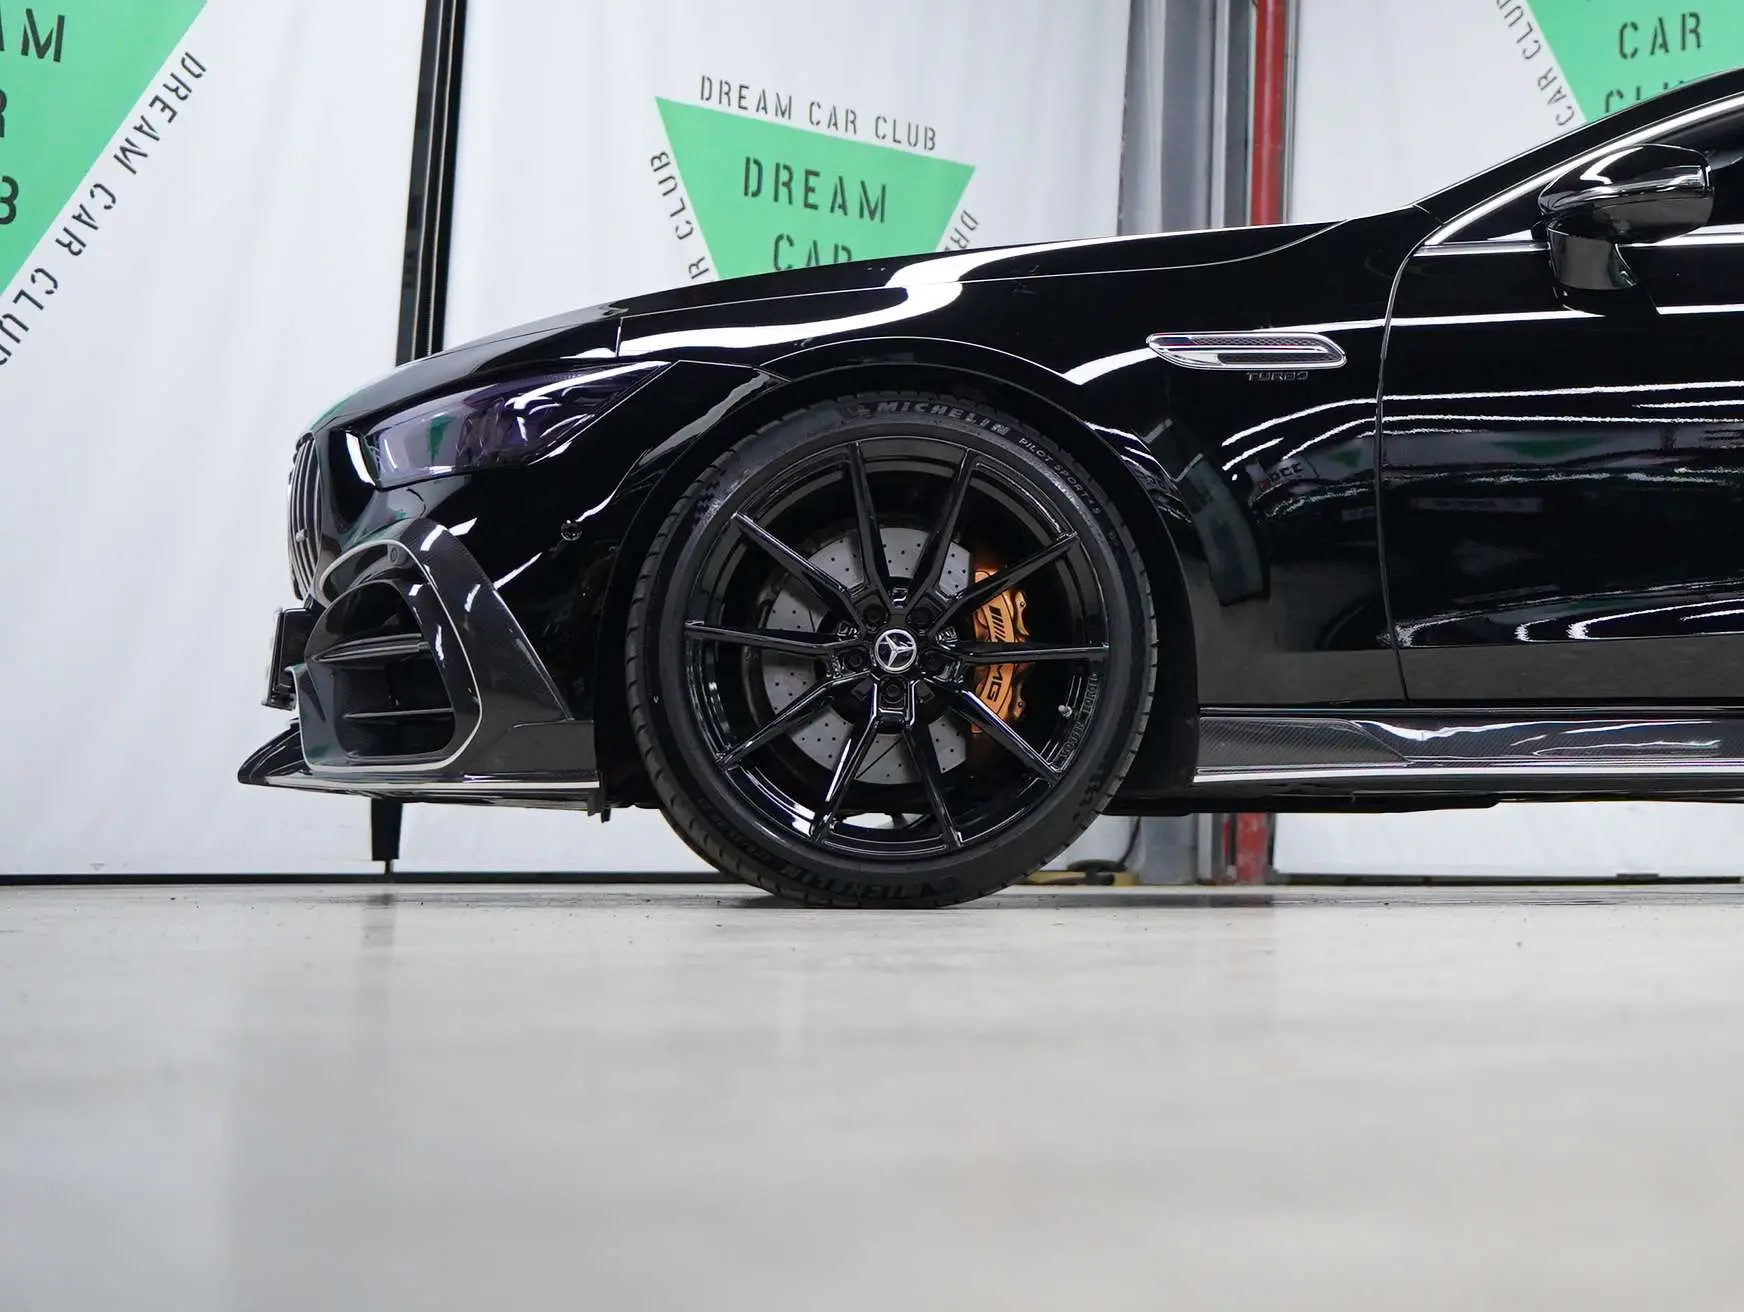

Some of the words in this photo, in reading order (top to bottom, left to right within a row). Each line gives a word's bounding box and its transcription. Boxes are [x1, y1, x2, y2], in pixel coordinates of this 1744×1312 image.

[1619, 12, 1703, 60] CAR
[114, 51, 208, 175] DREAM
[700, 74, 792, 120] DREAM
[809, 101, 857, 135] CAR
[875, 115, 937, 151] CLUB
[1537, 66, 1576, 126] CAR
[55, 182, 117, 258] CAR
[650, 150, 694, 240] CLUB
[743, 156, 888, 224] DREAM
[877, 401, 1011, 436] MICHELIN
